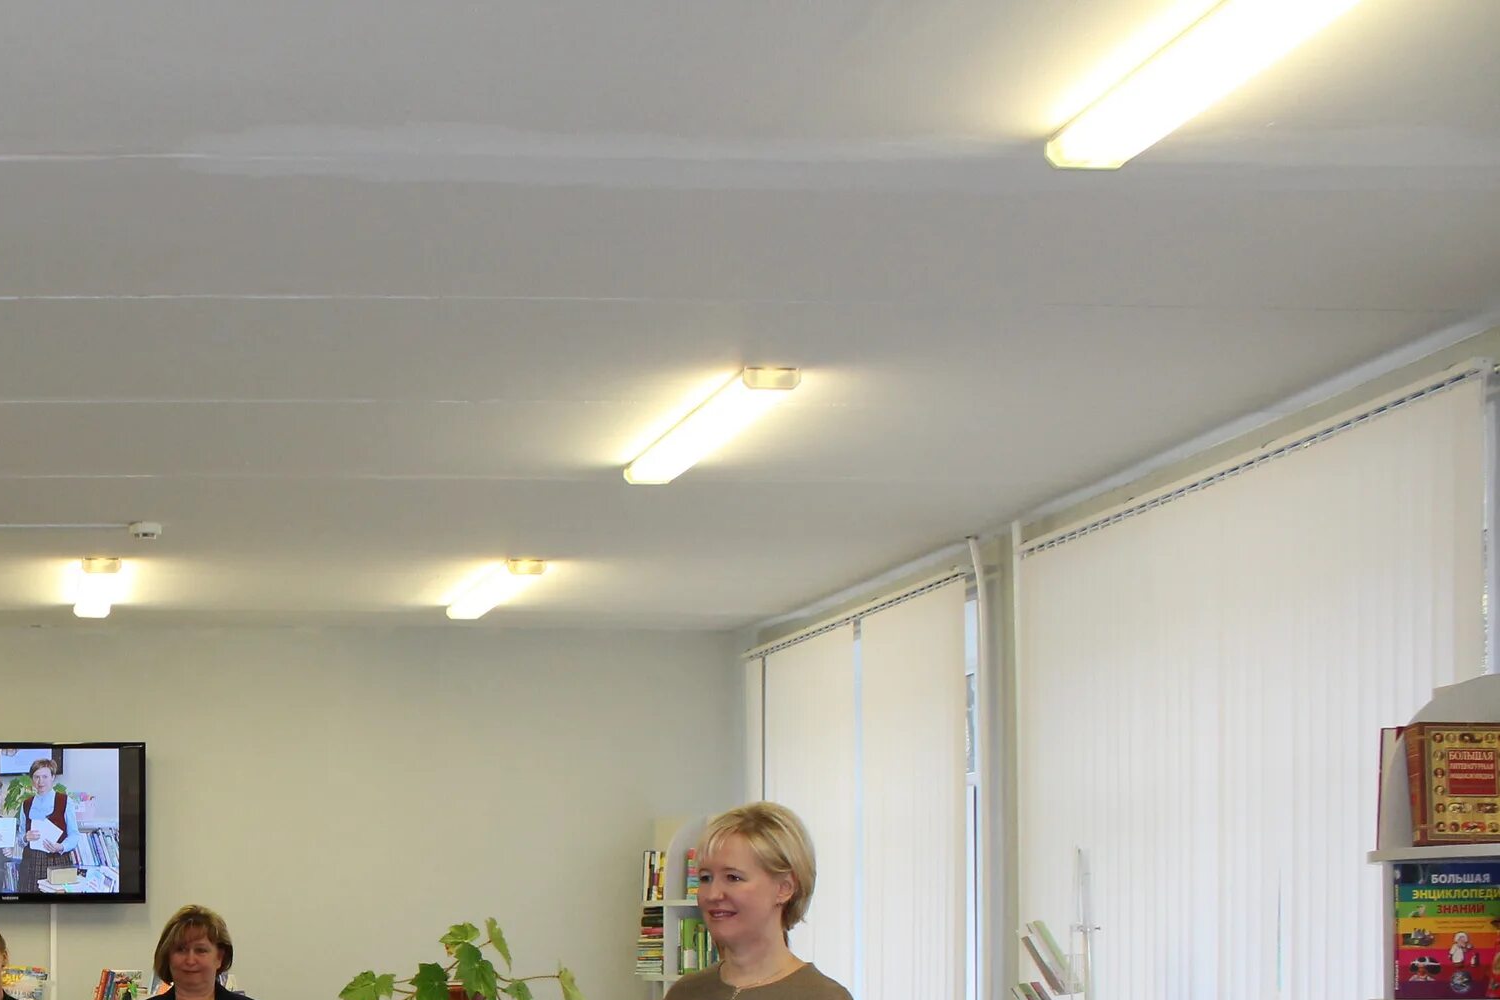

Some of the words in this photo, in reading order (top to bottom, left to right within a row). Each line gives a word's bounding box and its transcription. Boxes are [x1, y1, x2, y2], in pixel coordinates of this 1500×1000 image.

[1449, 750, 1494, 761] БОЛЬШАЯ
[1431, 873, 1491, 884] БОЛЬШАЯ
[1436, 903, 1485, 914] ЗНАНИЙ
